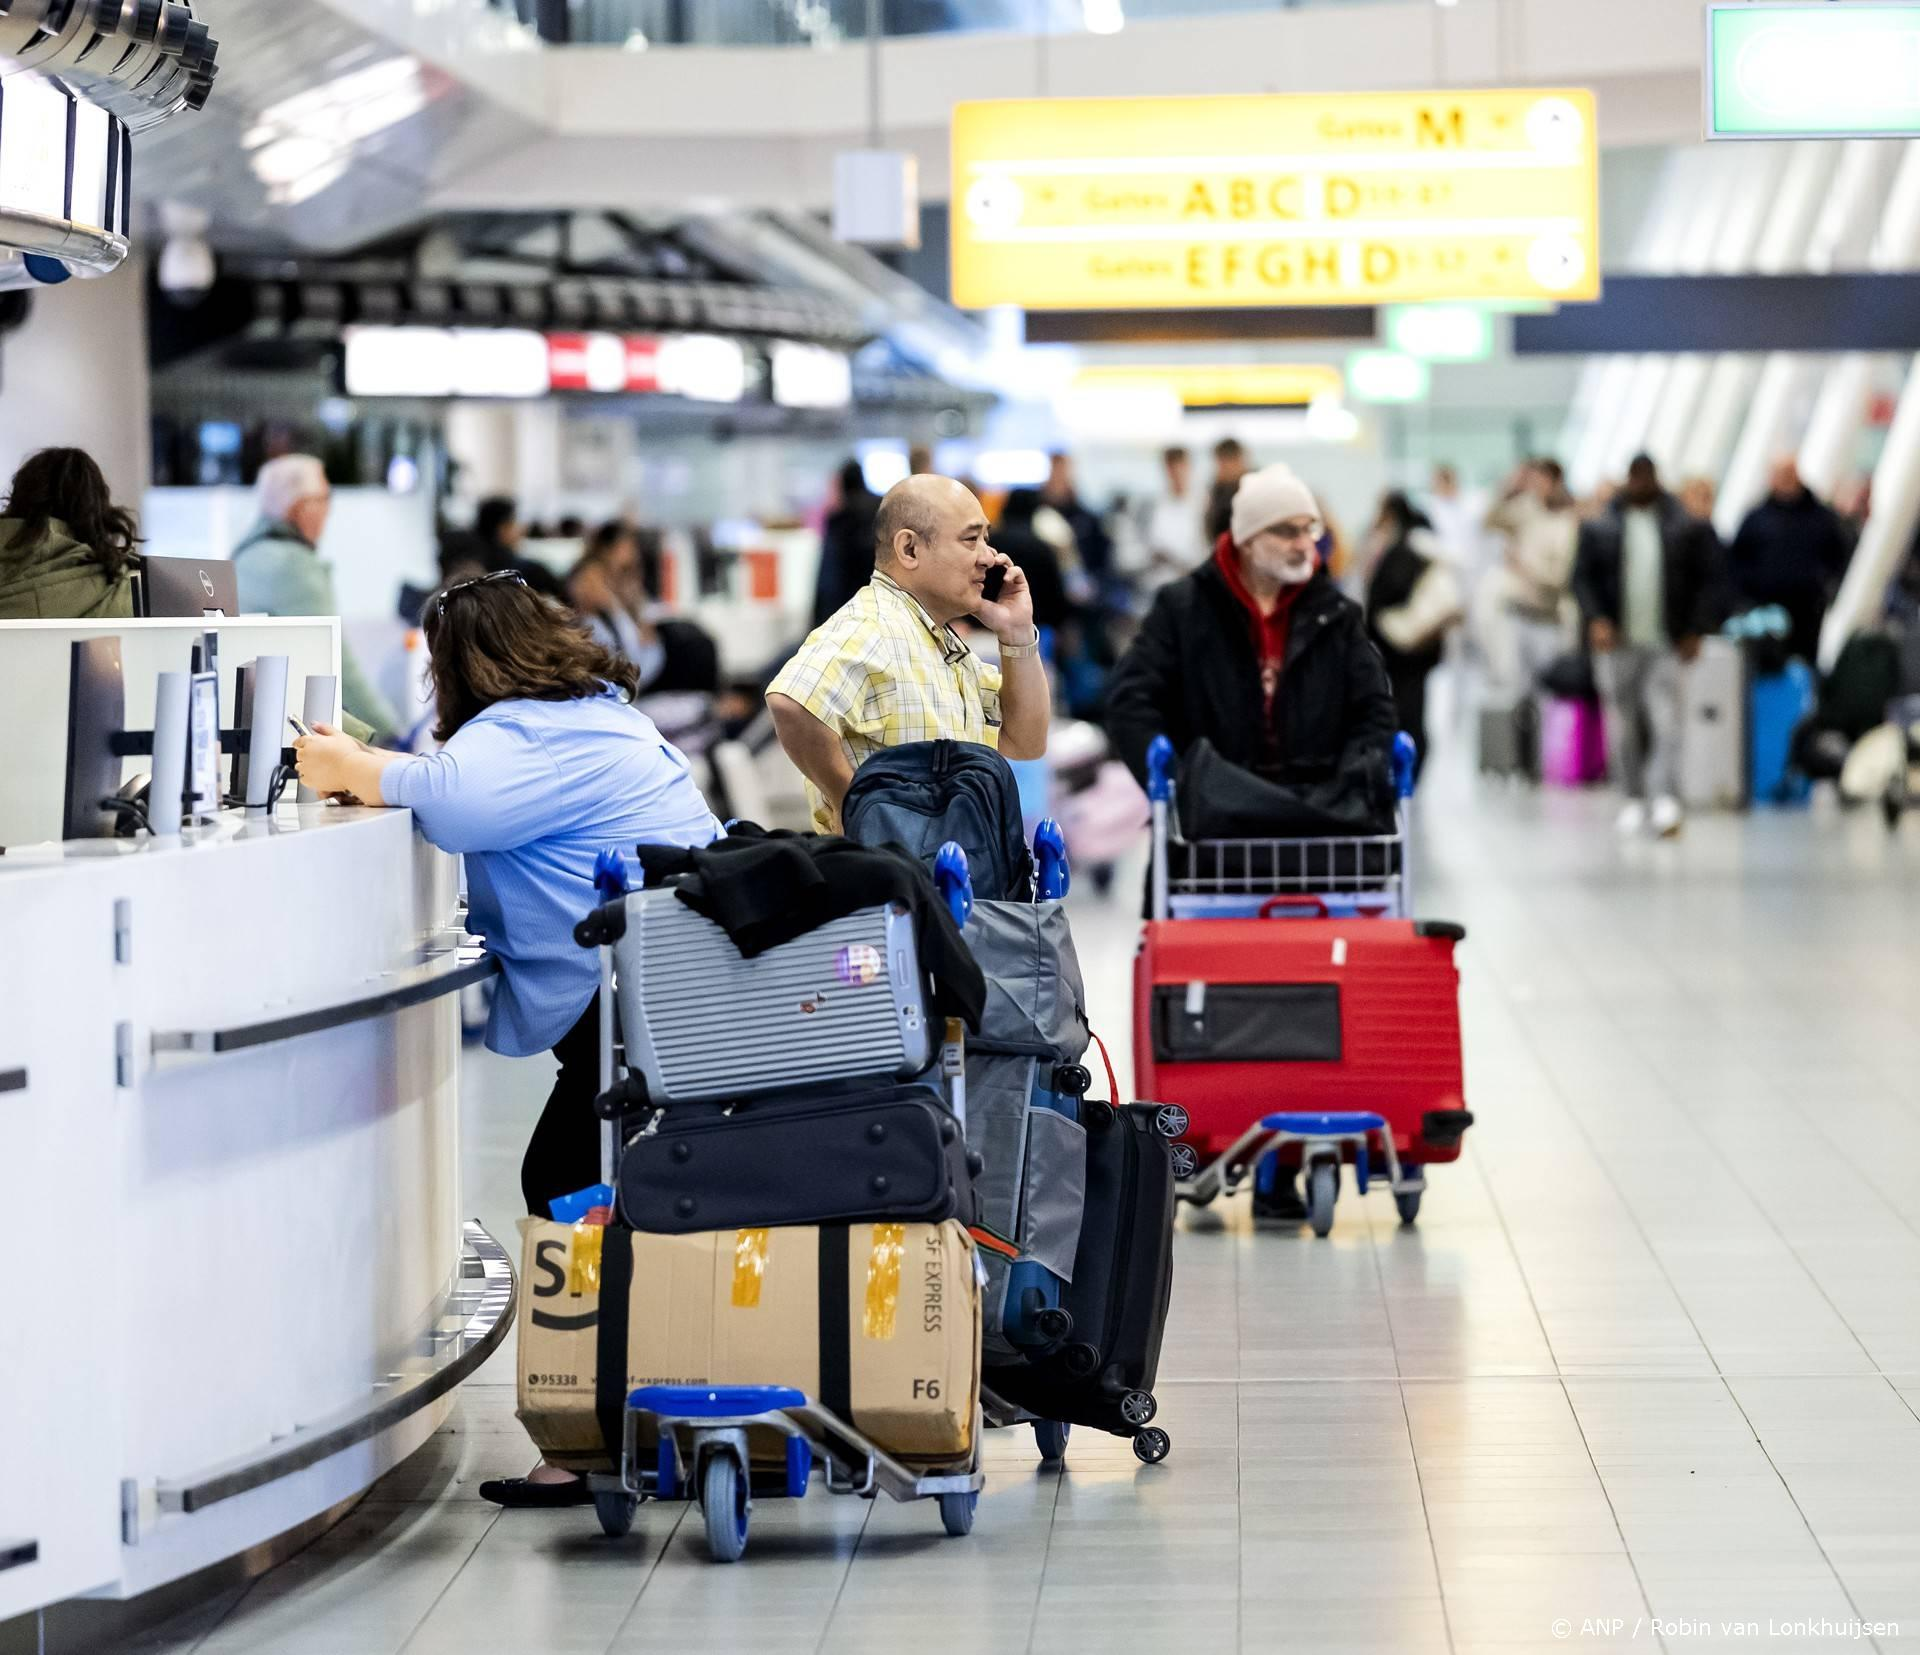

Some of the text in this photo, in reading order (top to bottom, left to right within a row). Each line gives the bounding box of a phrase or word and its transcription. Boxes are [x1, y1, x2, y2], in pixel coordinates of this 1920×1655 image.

[1415, 107, 1468, 148] M
[924, 1237, 942, 1333] SF EXPRESS
[541, 1374, 577, 1385] 95338
[912, 1379, 940, 1399] F6
